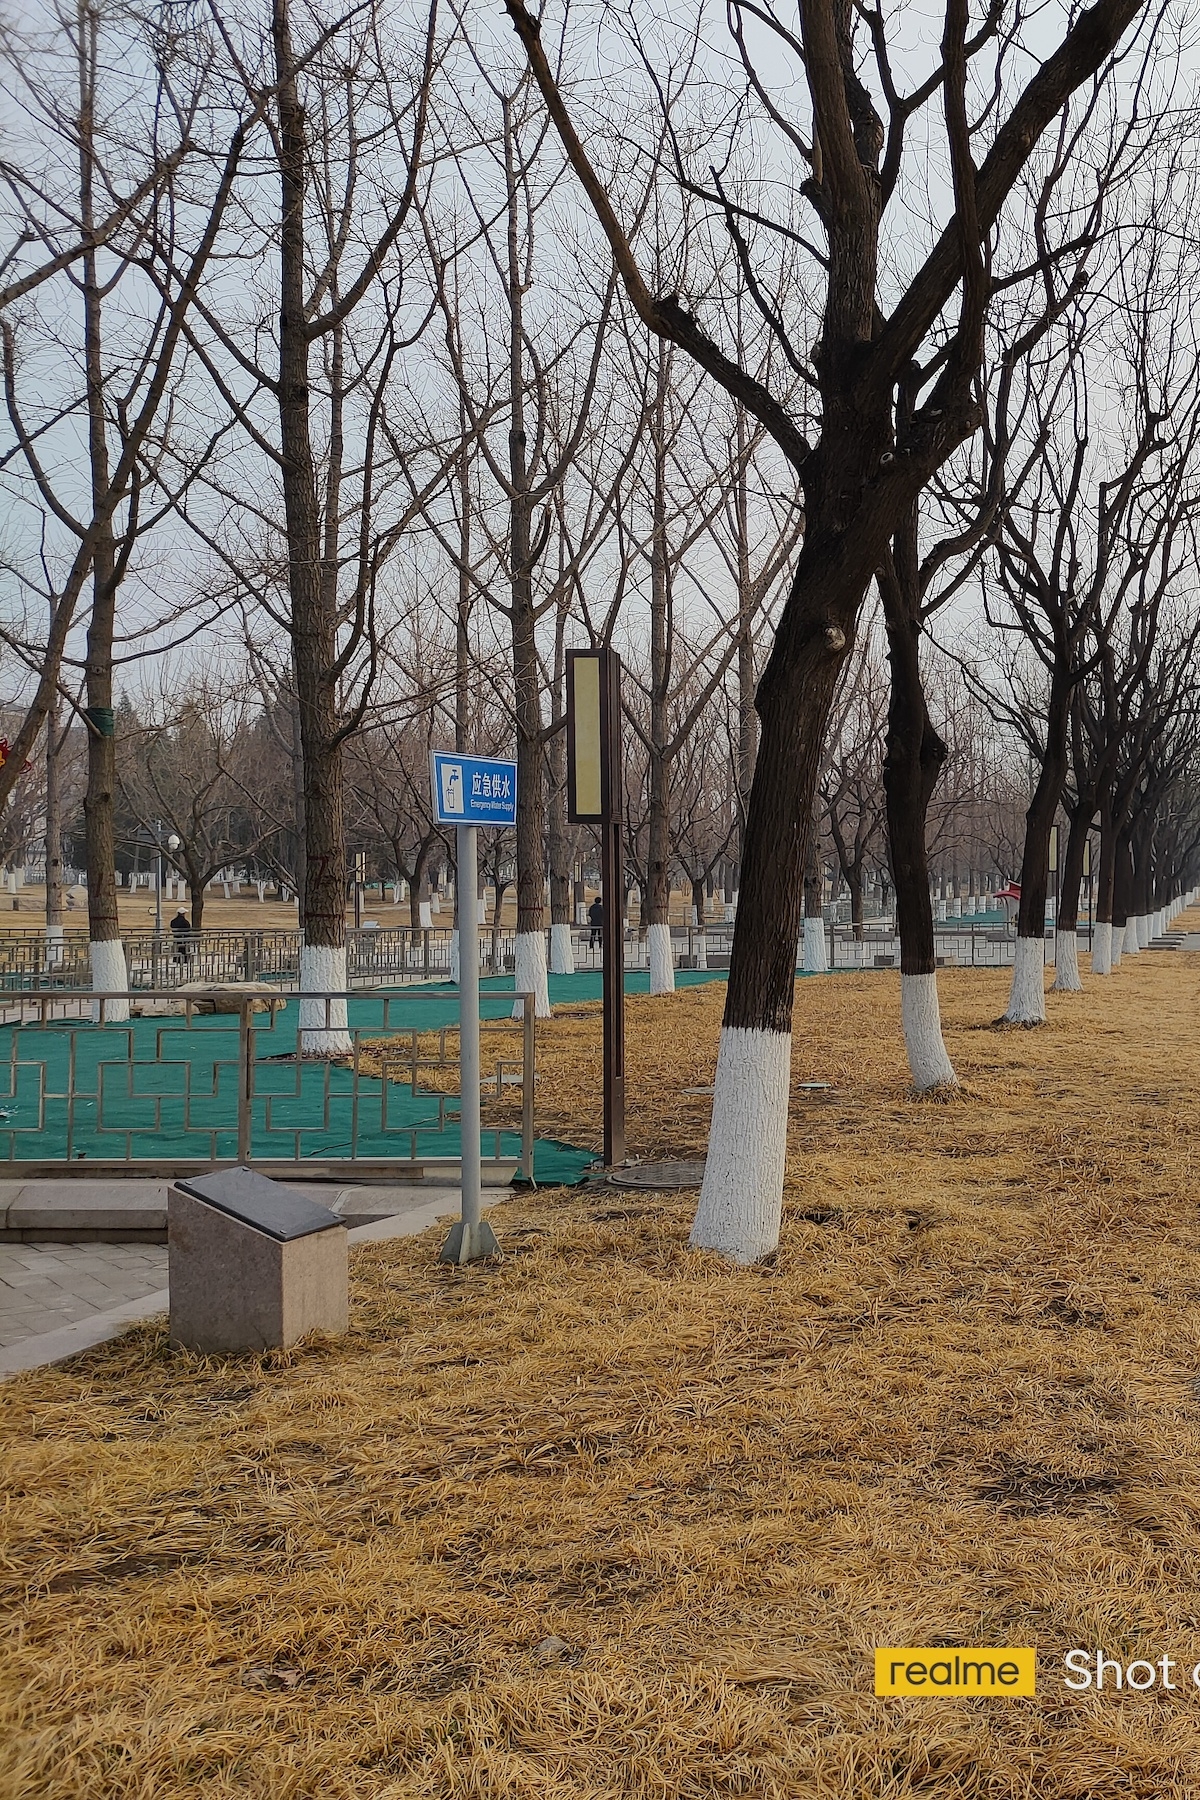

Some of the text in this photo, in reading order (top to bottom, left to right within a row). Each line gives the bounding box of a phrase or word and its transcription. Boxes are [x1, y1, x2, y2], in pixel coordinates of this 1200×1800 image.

[472, 771, 511, 799] 应急供水
[470, 799, 491, 811] Emergency
[501, 801, 514, 813] Supply
